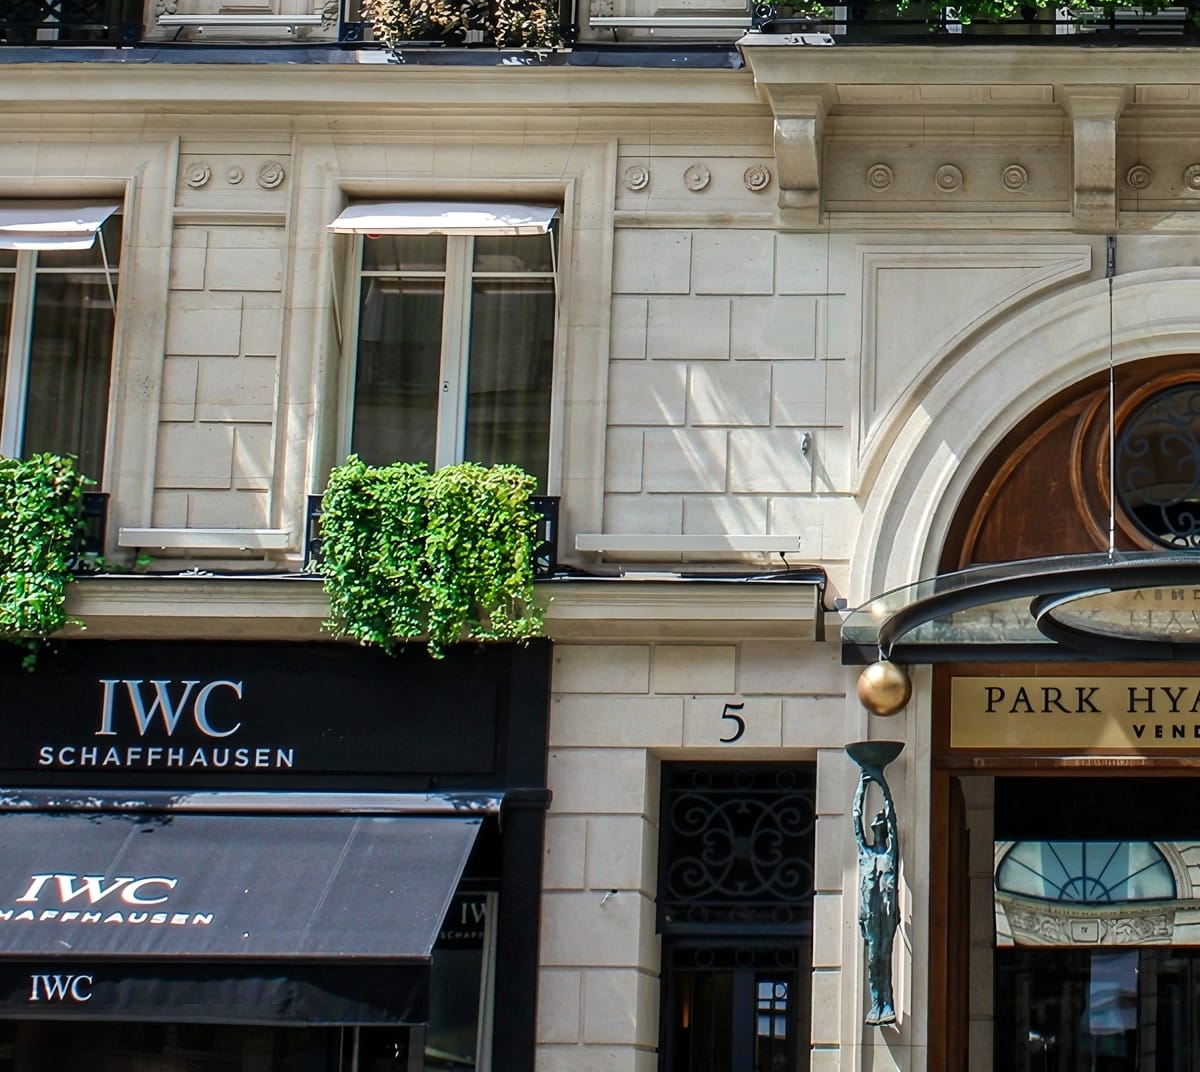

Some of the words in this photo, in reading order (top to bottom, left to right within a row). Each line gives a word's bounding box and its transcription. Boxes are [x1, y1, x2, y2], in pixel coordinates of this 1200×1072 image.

[94, 679, 243, 738] IWC
[984, 686, 1102, 714] PARK
[719, 702, 746, 743] 5
[38, 745, 295, 768] SCHAFFHAUSEN
[15, 873, 178, 905] IWC
[28, 974, 94, 1002] IWC
